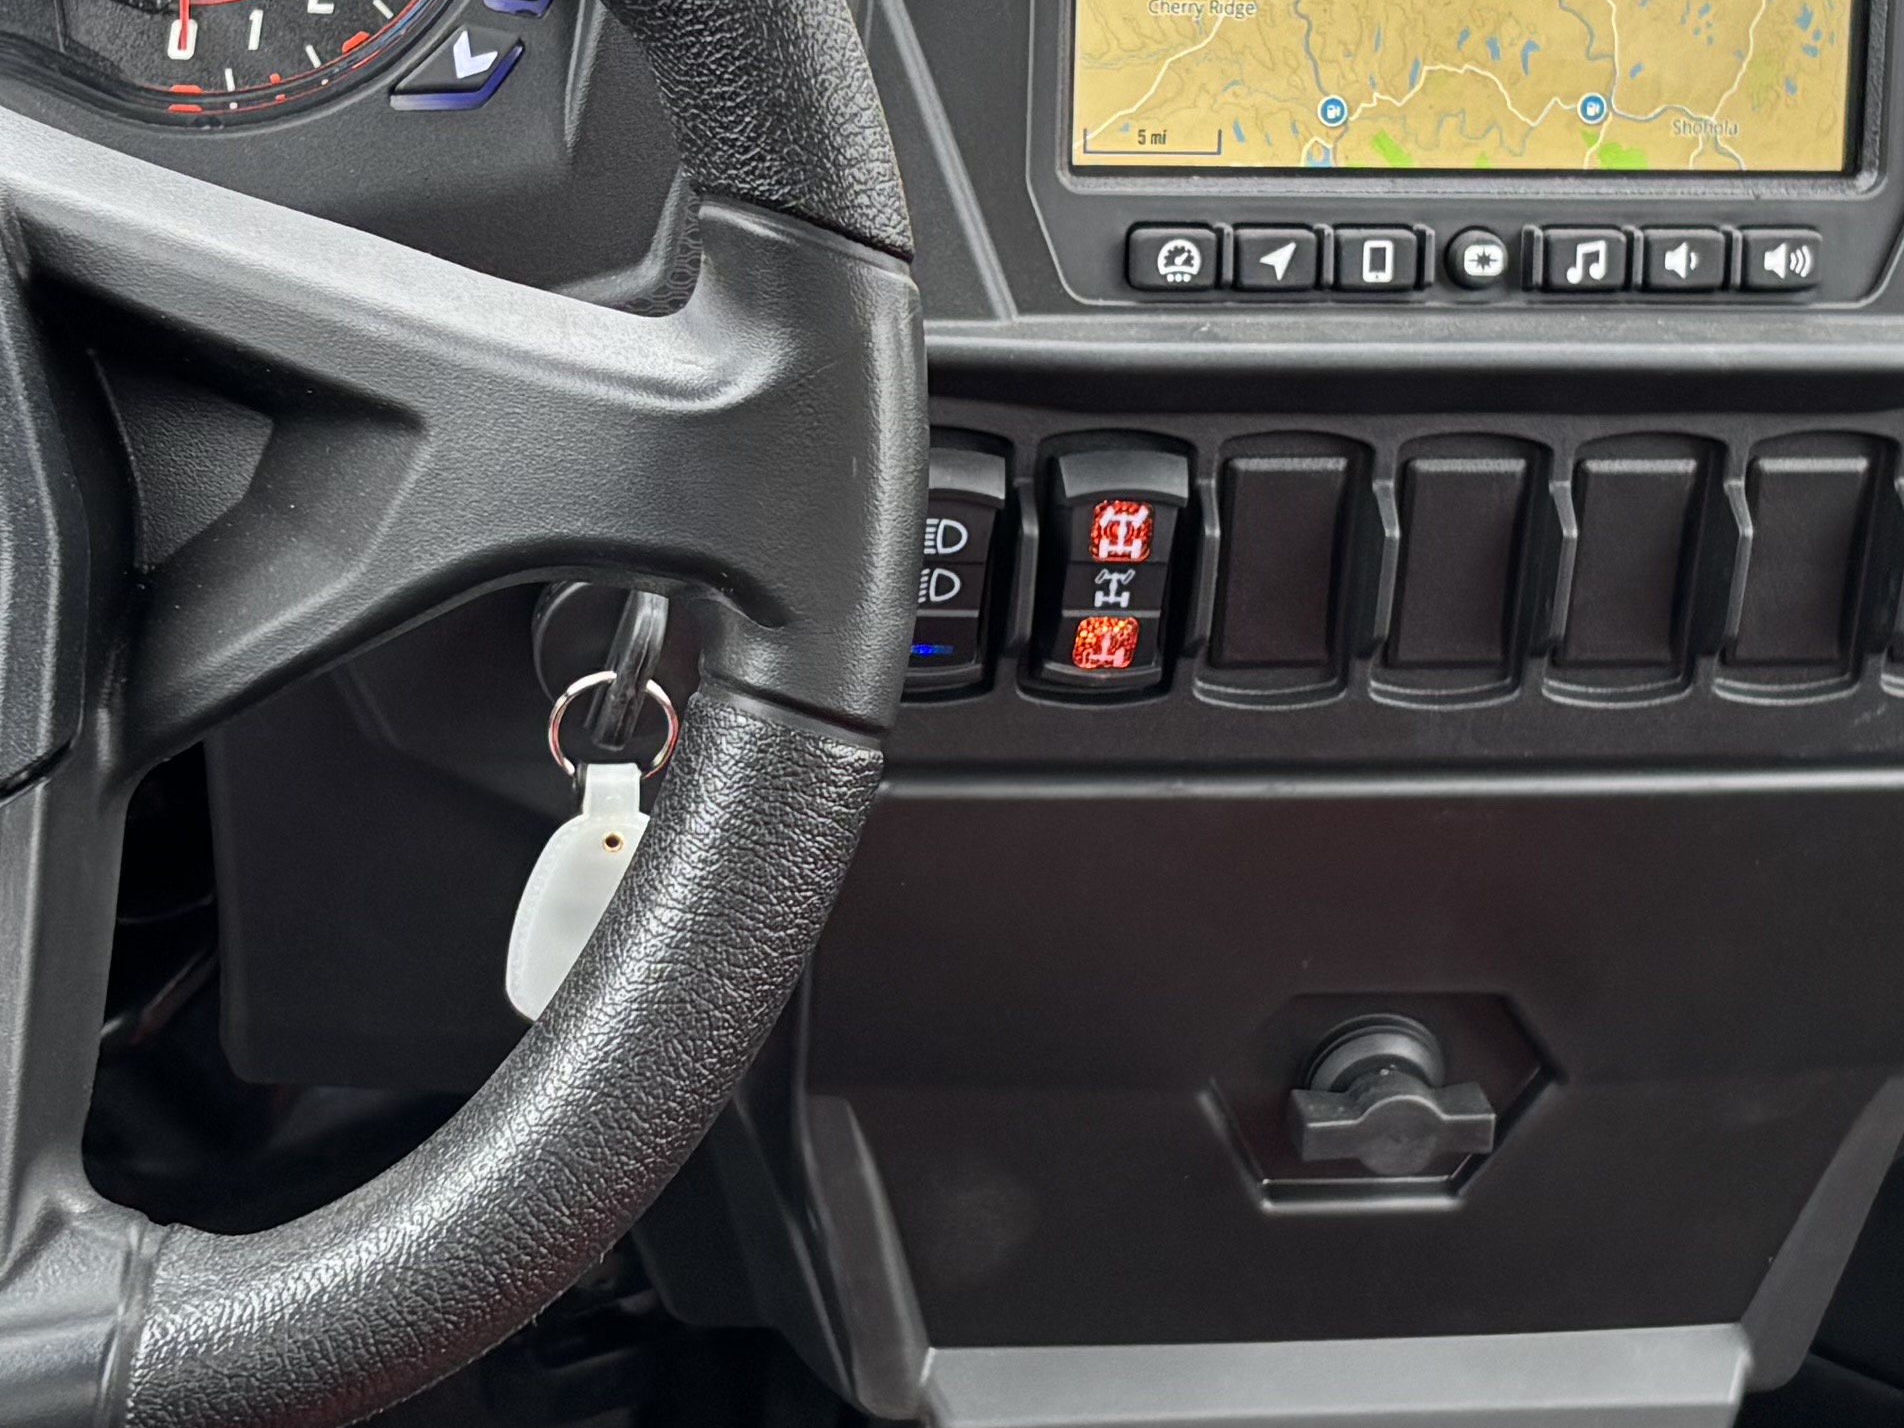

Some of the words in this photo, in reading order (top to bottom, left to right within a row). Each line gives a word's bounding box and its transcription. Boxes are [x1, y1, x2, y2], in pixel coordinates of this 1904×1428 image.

[1210, 0, 1255, 18] Ridge
[166, 19, 198, 60] 0
[247, 10, 264, 51] 1
[1138, 129, 1147, 145] 5
[1150, 129, 1167, 145] mi
